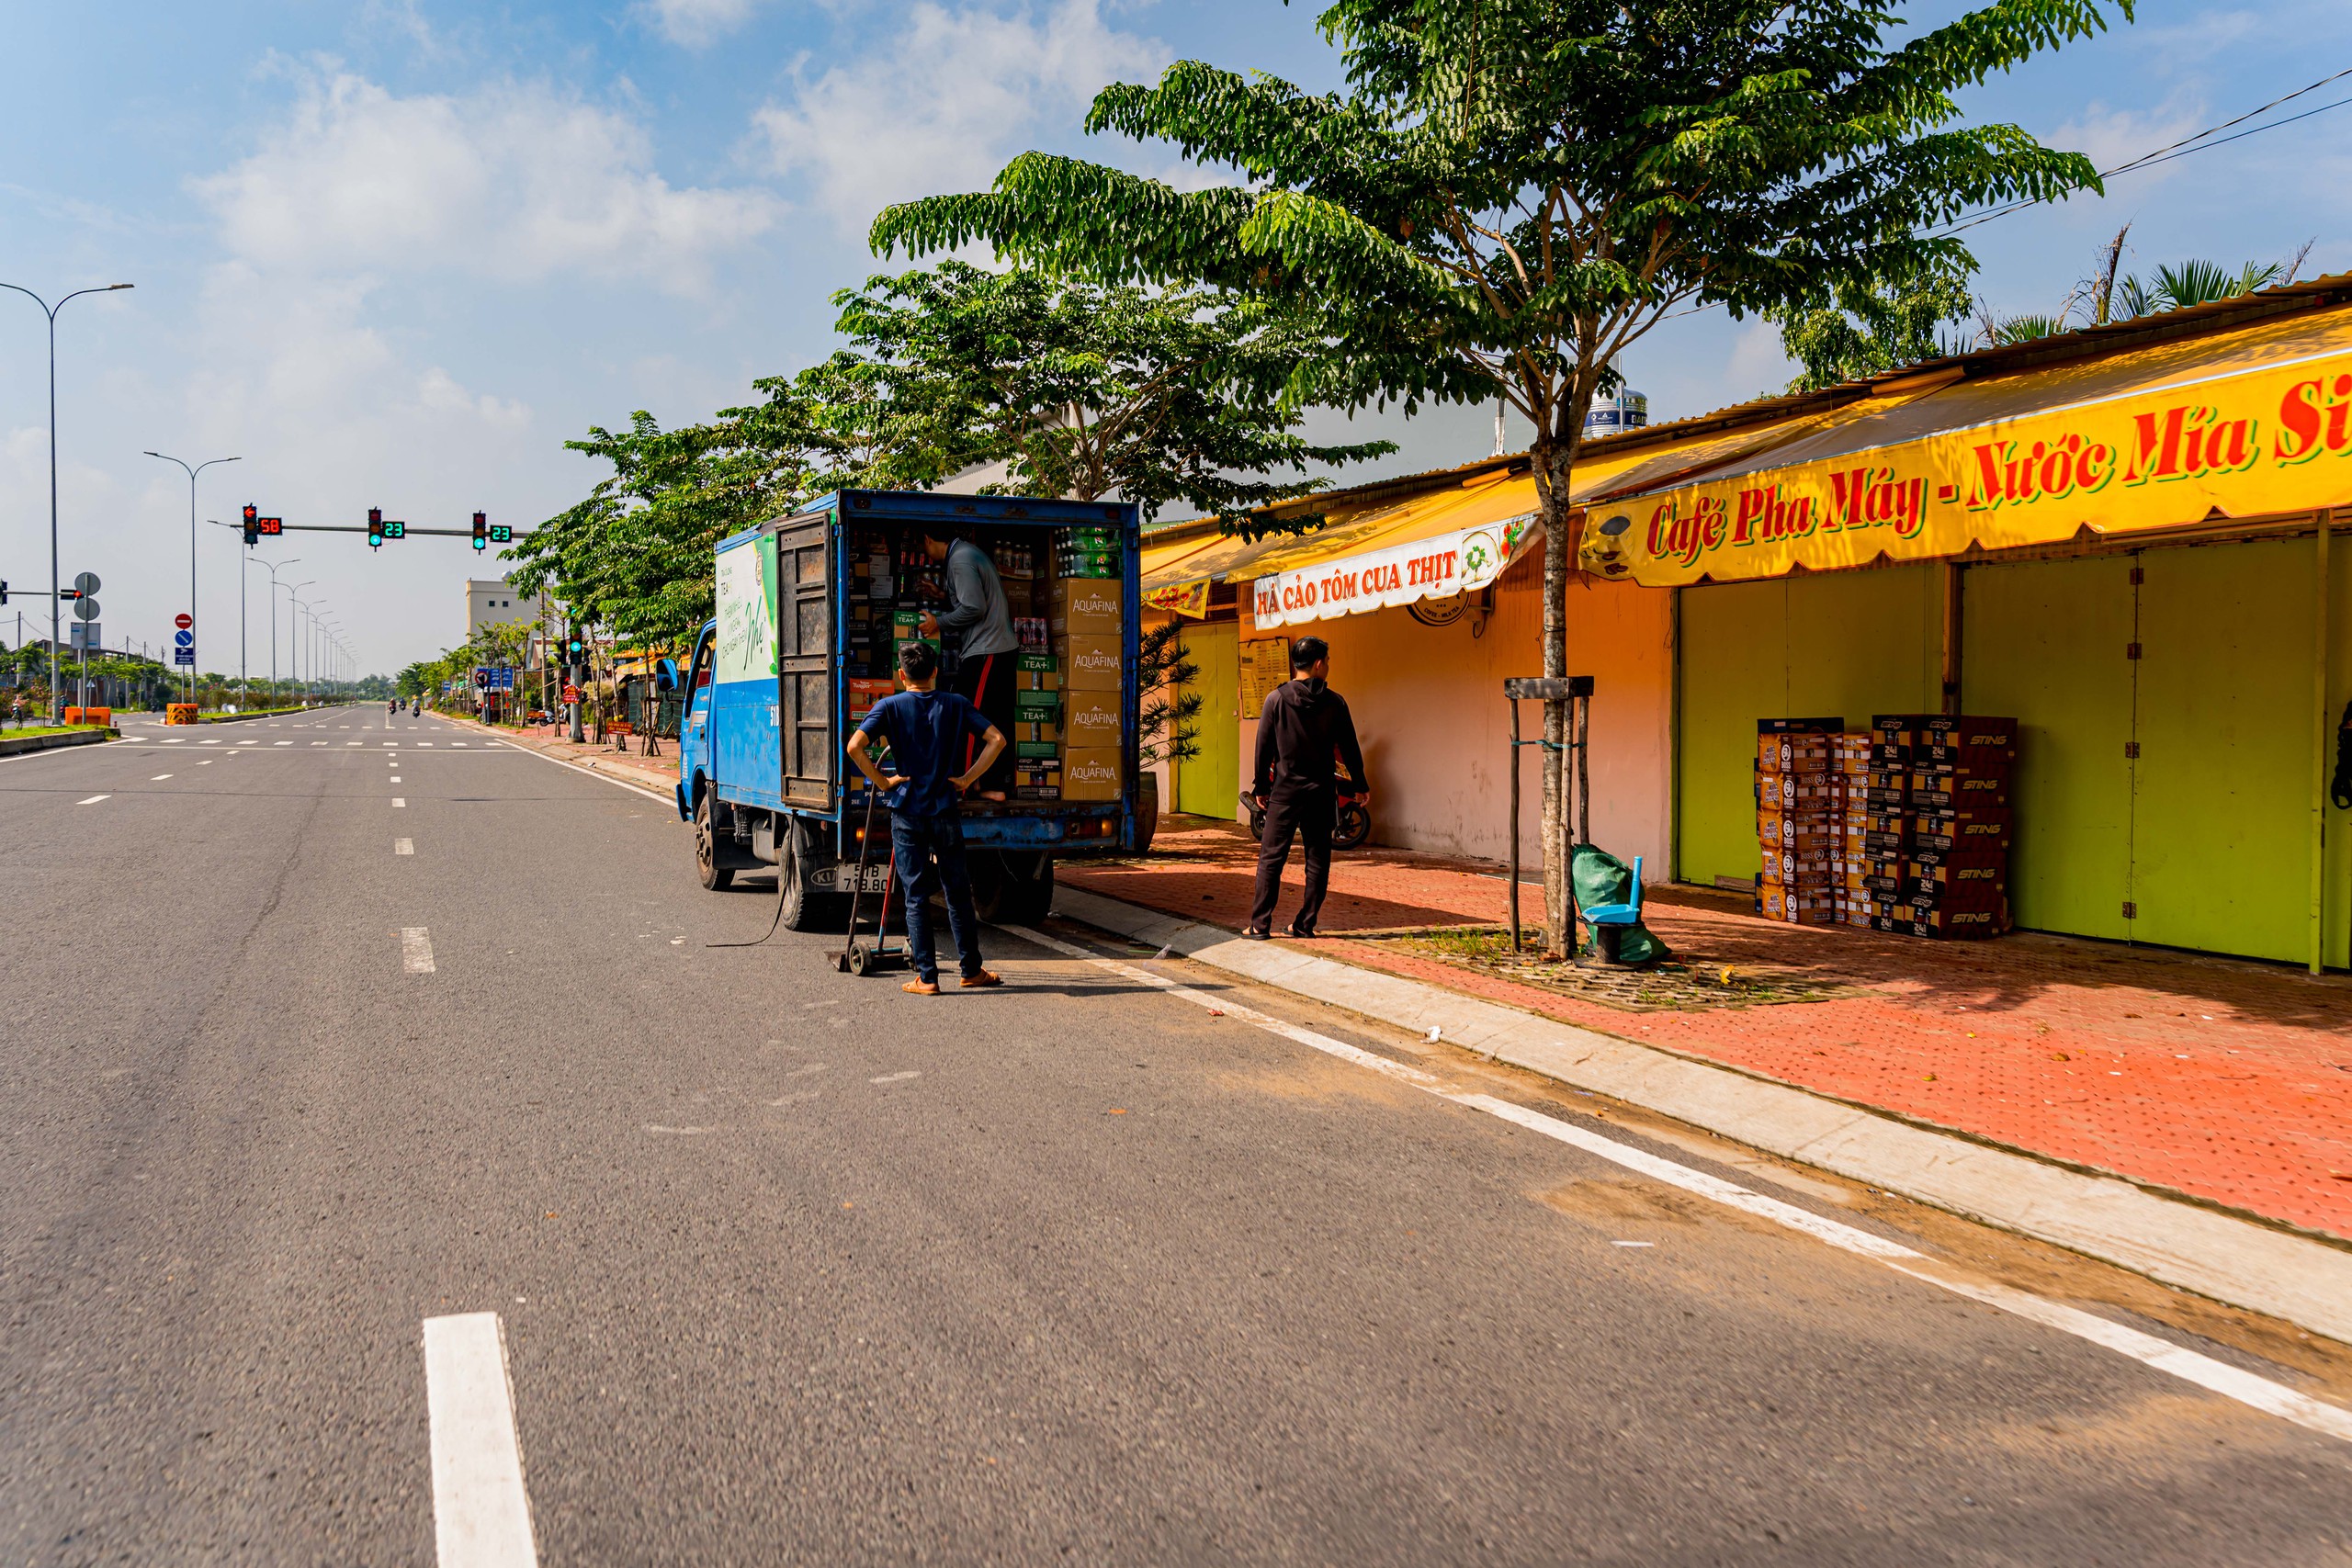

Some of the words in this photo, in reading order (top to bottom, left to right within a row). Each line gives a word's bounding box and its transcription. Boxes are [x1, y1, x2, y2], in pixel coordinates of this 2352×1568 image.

[1646, 496, 1727, 566] Café
[1731, 483, 1815, 545] Pha
[1820, 467, 1927, 538] Máy
[1966, 434, 2115, 512] Nước
[2121, 405, 2258, 485] Mía
[260, 519, 280, 533] 58
[384, 523, 402, 536] 23
[492, 526, 510, 540] 23
[1256, 582, 1281, 616] HÁ
[1283, 574, 1317, 611] CẢO
[1320, 568, 1360, 604] TÔM
[1362, 563, 1402, 597] CUA
[1407, 549, 1459, 591] THỊT
[1072, 598, 1120, 615] AQUAFINA
[1451, 605, 1460, 615] TEA
[1024, 660, 1047, 669] TEA+
[1074, 654, 1121, 670] AQUAFINA
[1023, 711, 1046, 720] TEA+
[1073, 711, 1121, 727] AQUAFINA
[1970, 735, 2007, 745] STING
[1070, 766, 1118, 781] AQUAFINA
[1962, 779, 1997, 790] STING
[1964, 824, 2001, 834] STING
[1957, 868, 1996, 879] STING
[1951, 912, 1991, 924] STING
